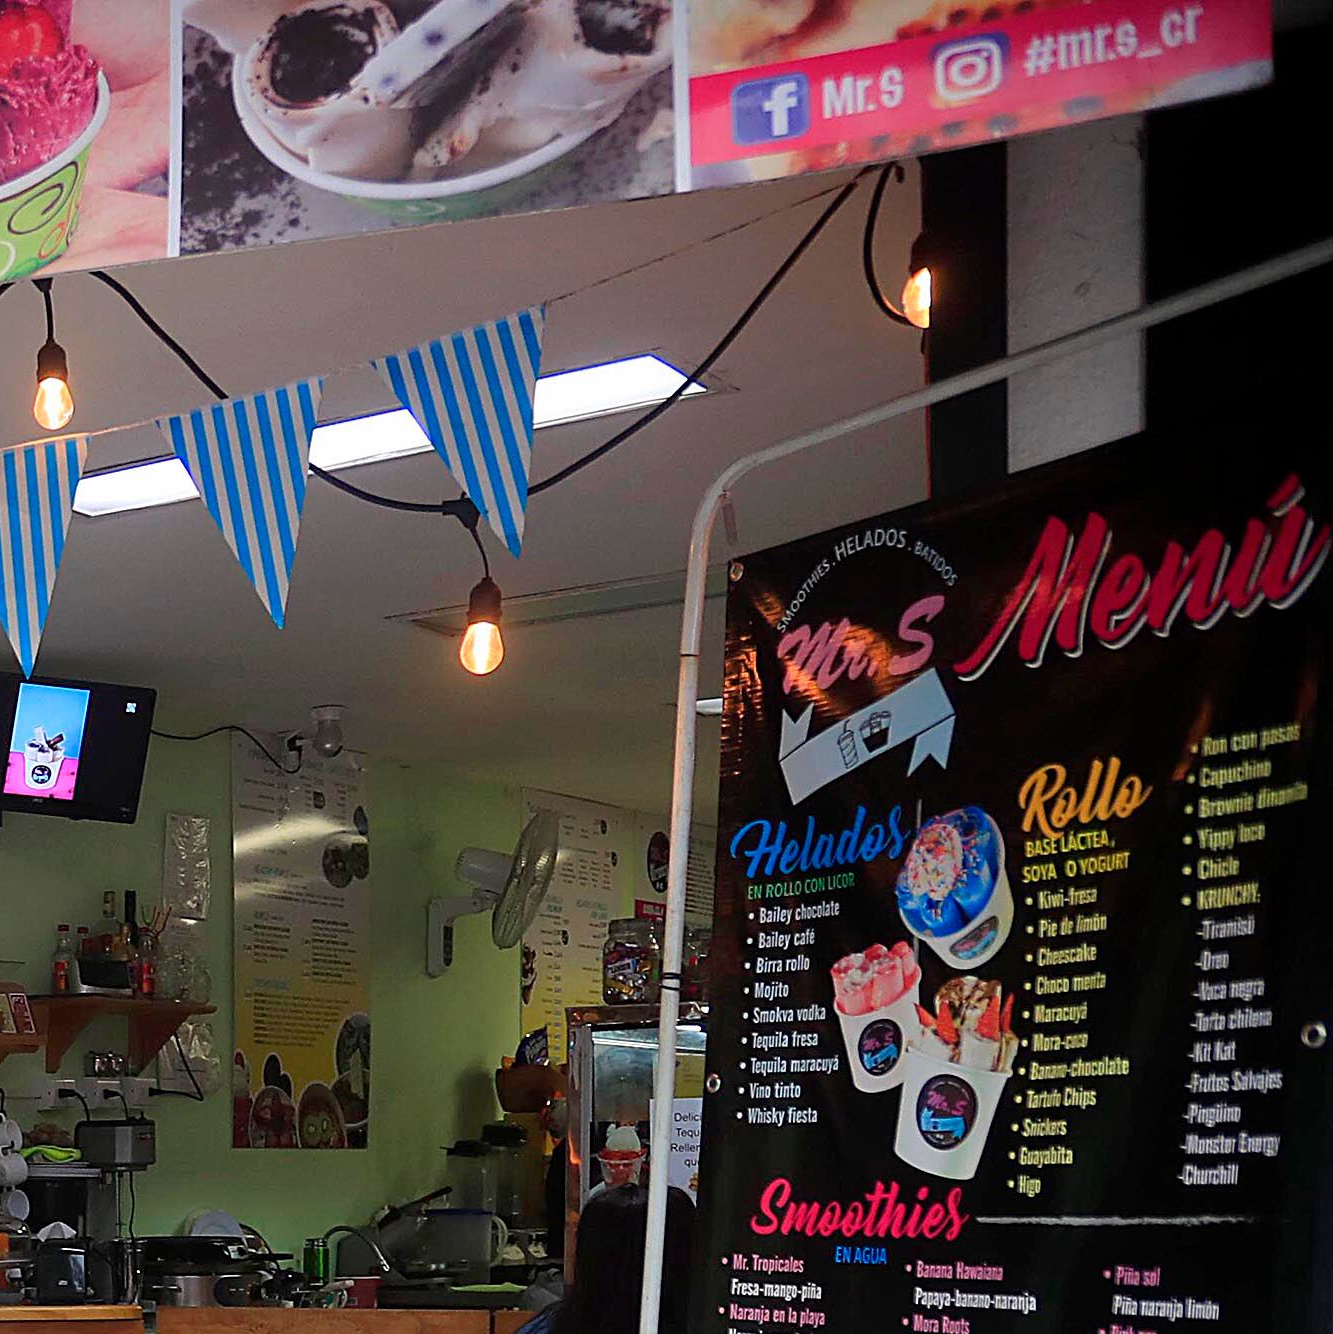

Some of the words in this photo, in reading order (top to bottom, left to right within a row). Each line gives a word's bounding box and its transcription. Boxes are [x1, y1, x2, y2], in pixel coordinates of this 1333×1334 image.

[1023, 6, 1205, 78] #mr.s_cr
[777, 560, 831, 634] SMOOTHIES
[835, 528, 907, 561] HELADOS
[914, 542, 959, 587] BATIDOS
[953, 471, 1332, 682] Menú
[777, 616, 878, 697] Mr.
[891, 595, 945, 675] S
[1018, 757, 1154, 839] Rollo
[730, 803, 912, 879] Helados
[1025, 838, 1058, 858] BASE
[1022, 862, 1058, 884] SOYA
[1065, 860, 1077, 877] O
[1079, 852, 1131, 875] YOGURT
[747, 884, 762, 900] EN
[766, 879, 802, 899] ROLLO
[804, 876, 825, 895] CON
[825, 872, 854, 892] LICOR
[759, 905, 793, 926] Bailey
[795, 900, 840, 920] chocolate
[758, 930, 791, 951] Bailey
[794, 927, 815, 946] café
[756, 956, 782, 973] Birra
[785, 954, 810, 972] rollo
[754, 981, 789, 1001] Mojito
[753, 1007, 794, 1024] Smokva
[797, 1005, 826, 1021] vodka
[752, 1031, 789, 1050] Tequila
[792, 1030, 818, 1047] fresa
[750, 1056, 787, 1075] Tequila
[790, 1054, 839, 1073] maracuyá
[750, 1081, 772, 1099] Vino
[774, 1080, 801, 1098] tinto
[747, 1106, 785, 1126] Whisky
[787, 1105, 818, 1124] fiesta
[1021, 1118, 1067, 1137] Snickers
[1019, 1146, 1073, 1168] Guayabita
[1018, 1175, 1041, 1198] Higo
[750, 1178, 969, 1241] Smoothies
[733, 1254, 749, 1271] Mr.
[753, 1255, 804, 1274] Tropicales
[836, 1246, 852, 1264] EN
[854, 1247, 887, 1265] AGUA
[731, 1278, 822, 1302] Fresa-mango-piña
